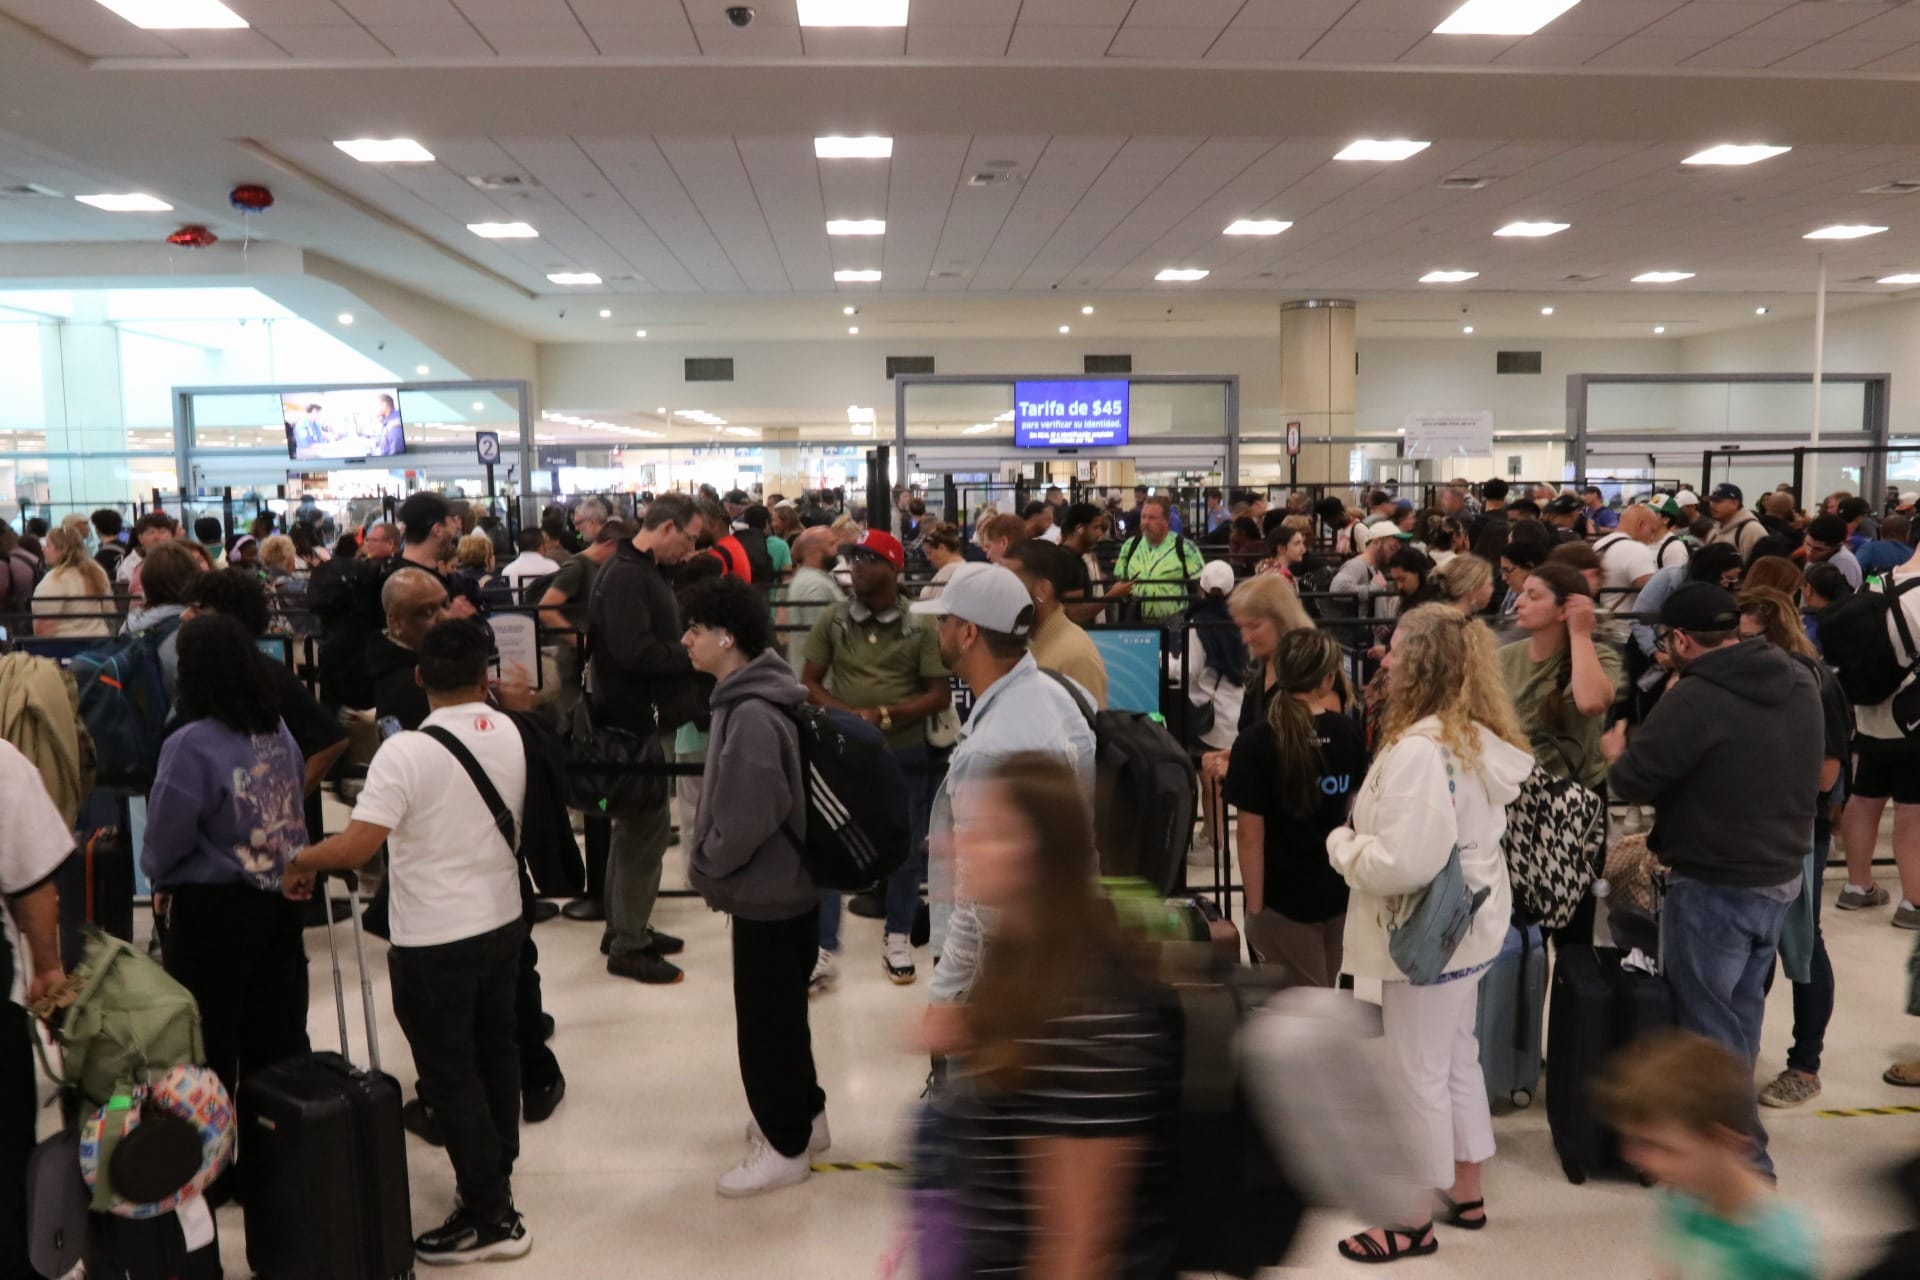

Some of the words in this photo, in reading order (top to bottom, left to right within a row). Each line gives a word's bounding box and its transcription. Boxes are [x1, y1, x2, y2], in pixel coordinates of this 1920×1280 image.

[1018, 400, 1064, 416] Tarifa
[1068, 400, 1089, 416] de
[1092, 399, 1122, 416] $45
[1021, 421, 1039, 430] para
[1040, 420, 1072, 429] verificar
[483, 440, 494, 456] 2
